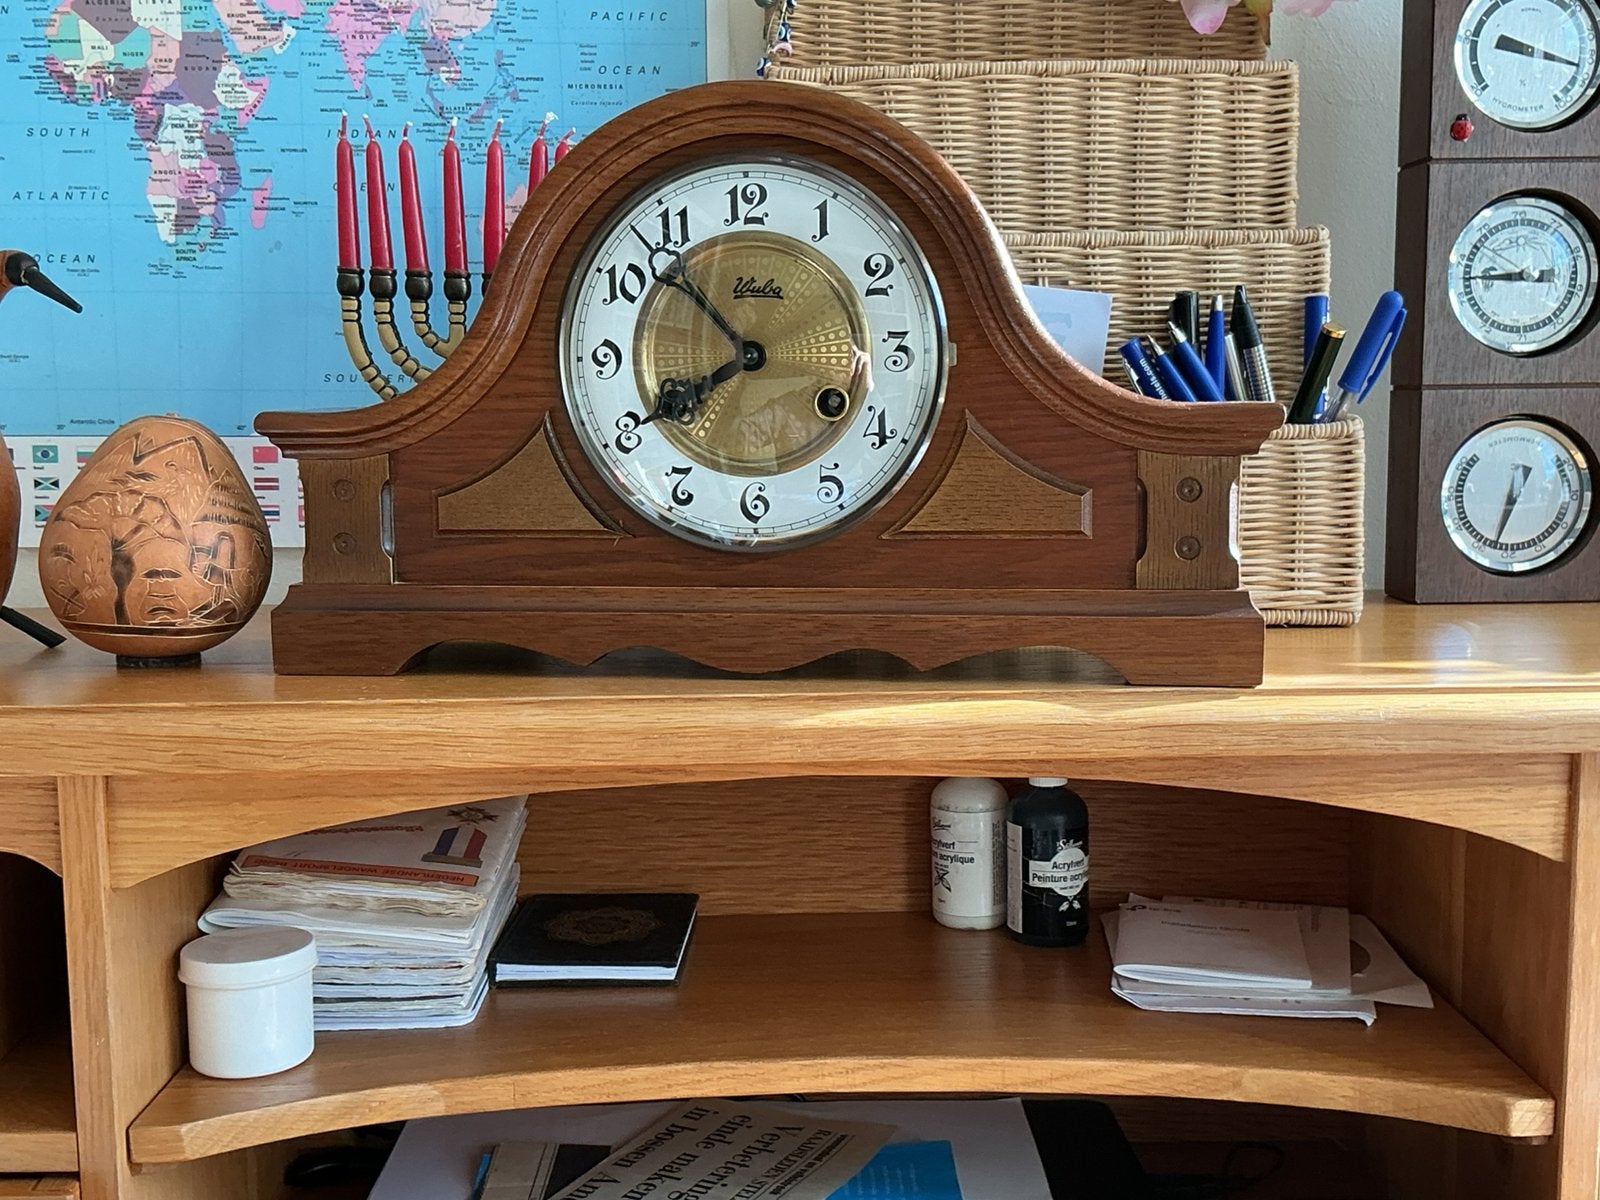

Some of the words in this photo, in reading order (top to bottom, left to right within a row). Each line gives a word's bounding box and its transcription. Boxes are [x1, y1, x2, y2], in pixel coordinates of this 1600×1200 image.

[590, 12, 668, 21] PACIFIC
[598, 65, 662, 75] OCEAN
[1493, 97, 1545, 113] HYGROMETER
[1554, 95, 1573, 111] 100
[26, 127, 90, 138] SOUTH
[13, 191, 110, 201] ATLANTIC
[333, 183, 395, 191] OEN
[723, 182, 769, 226] 12
[655, 205, 692, 249] 11
[811, 199, 829, 242] 1
[33, 254, 95, 263] OCEAN
[602, 262, 646, 305] 10
[863, 252, 895, 297] 2
[591, 338, 623, 380] 9
[882, 330, 916, 373] 3
[324, 374, 413, 383] SOUER
[614, 410, 643, 455] 8
[862, 405, 898, 450] 4
[665, 465, 695, 507] 7
[816, 462, 845, 504] 5
[739, 482, 771, 524] 6
[1560, 521, 1569, 531] 0
[1500, 550, 1518, 559] 20
[293, 862, 377, 874] WANDELSPORT
[939, 853, 975, 865] acrylique
[382, 868, 465, 882] NEDERLANDSE
[1032, 873, 1068, 883] Peinture
[681, 1106, 719, 1121] in
[695, 1115, 752, 1150] einde
[612, 1123, 698, 1168] bossen
[668, 1126, 805, 1200] Verbetering
[621, 1152, 699, 1200] maken
